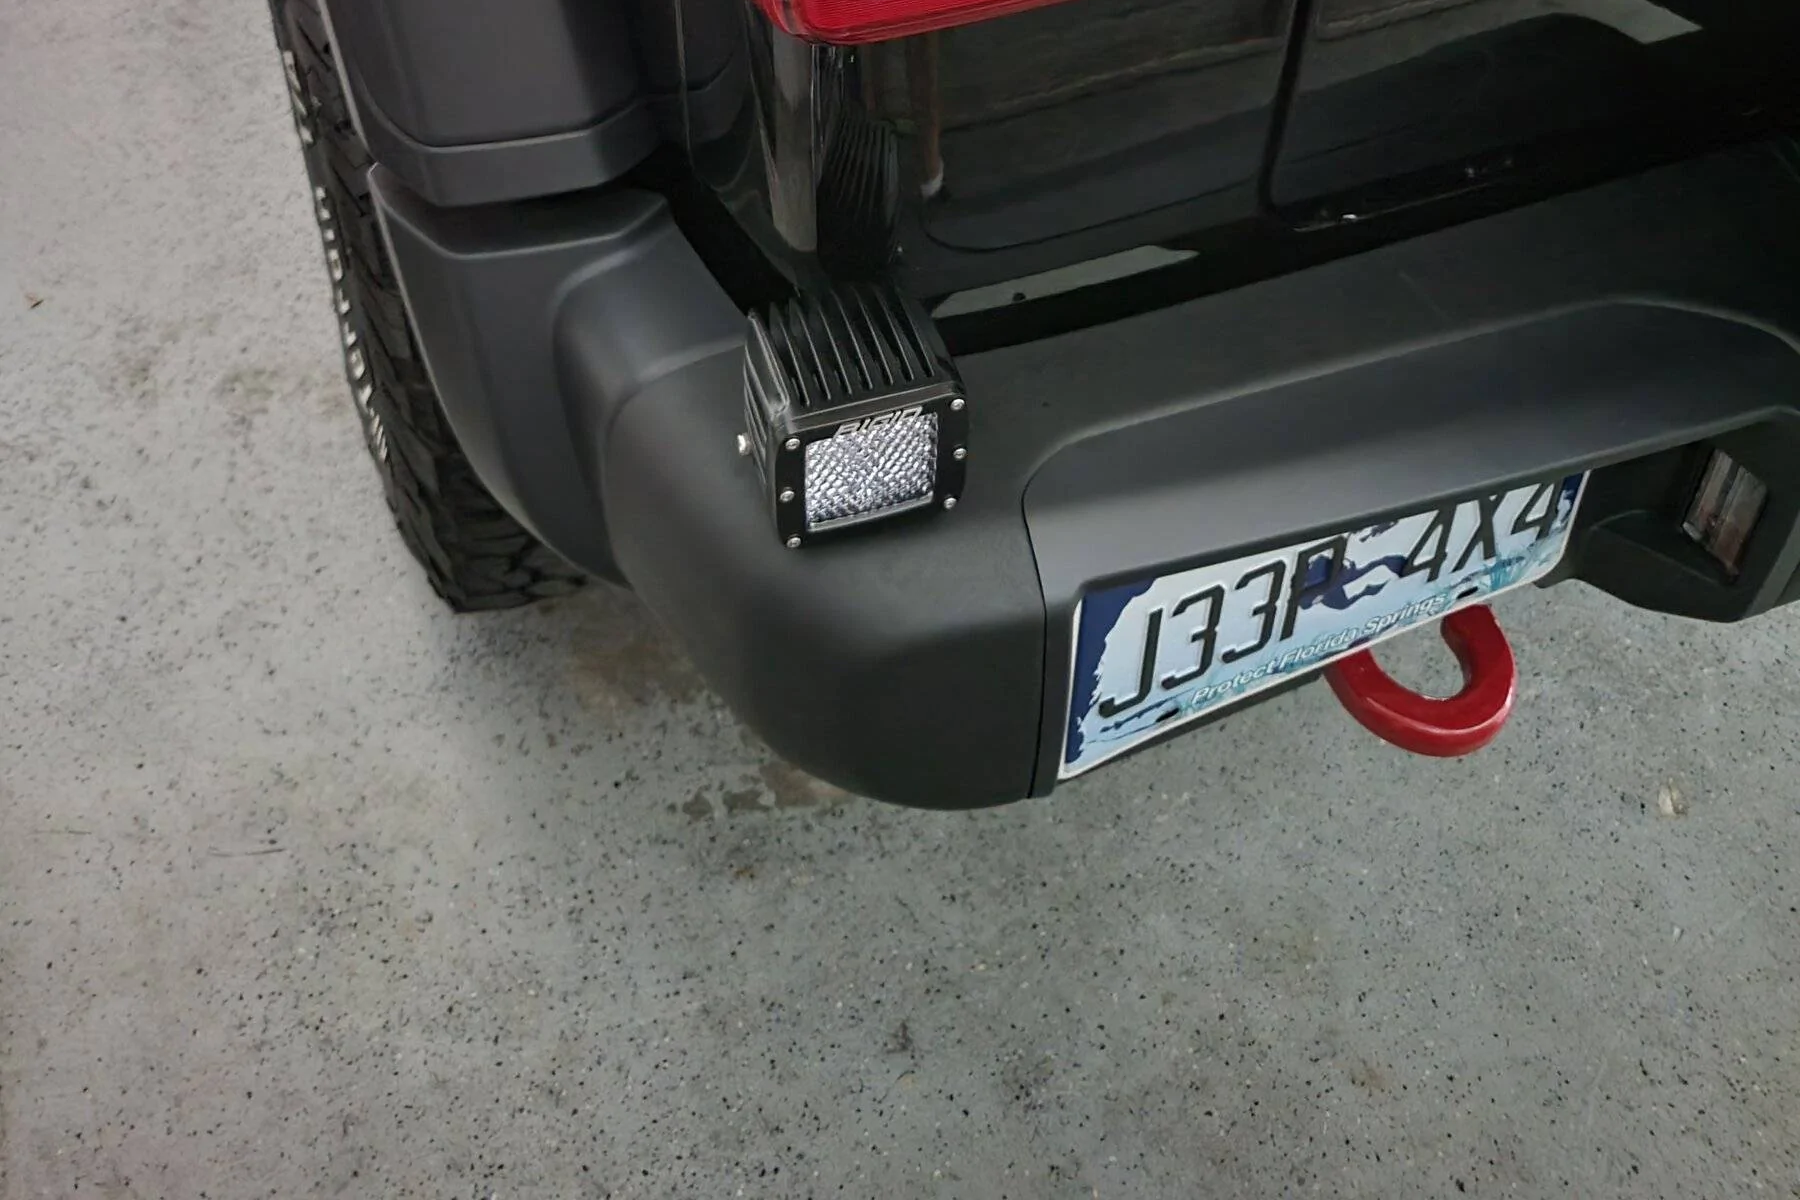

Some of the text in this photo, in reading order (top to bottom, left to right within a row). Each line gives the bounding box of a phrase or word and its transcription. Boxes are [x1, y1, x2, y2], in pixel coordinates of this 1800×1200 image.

[1098, 482, 1561, 719] J33P 4X4
[1192, 592, 1449, 704] Protect Florida Springs
